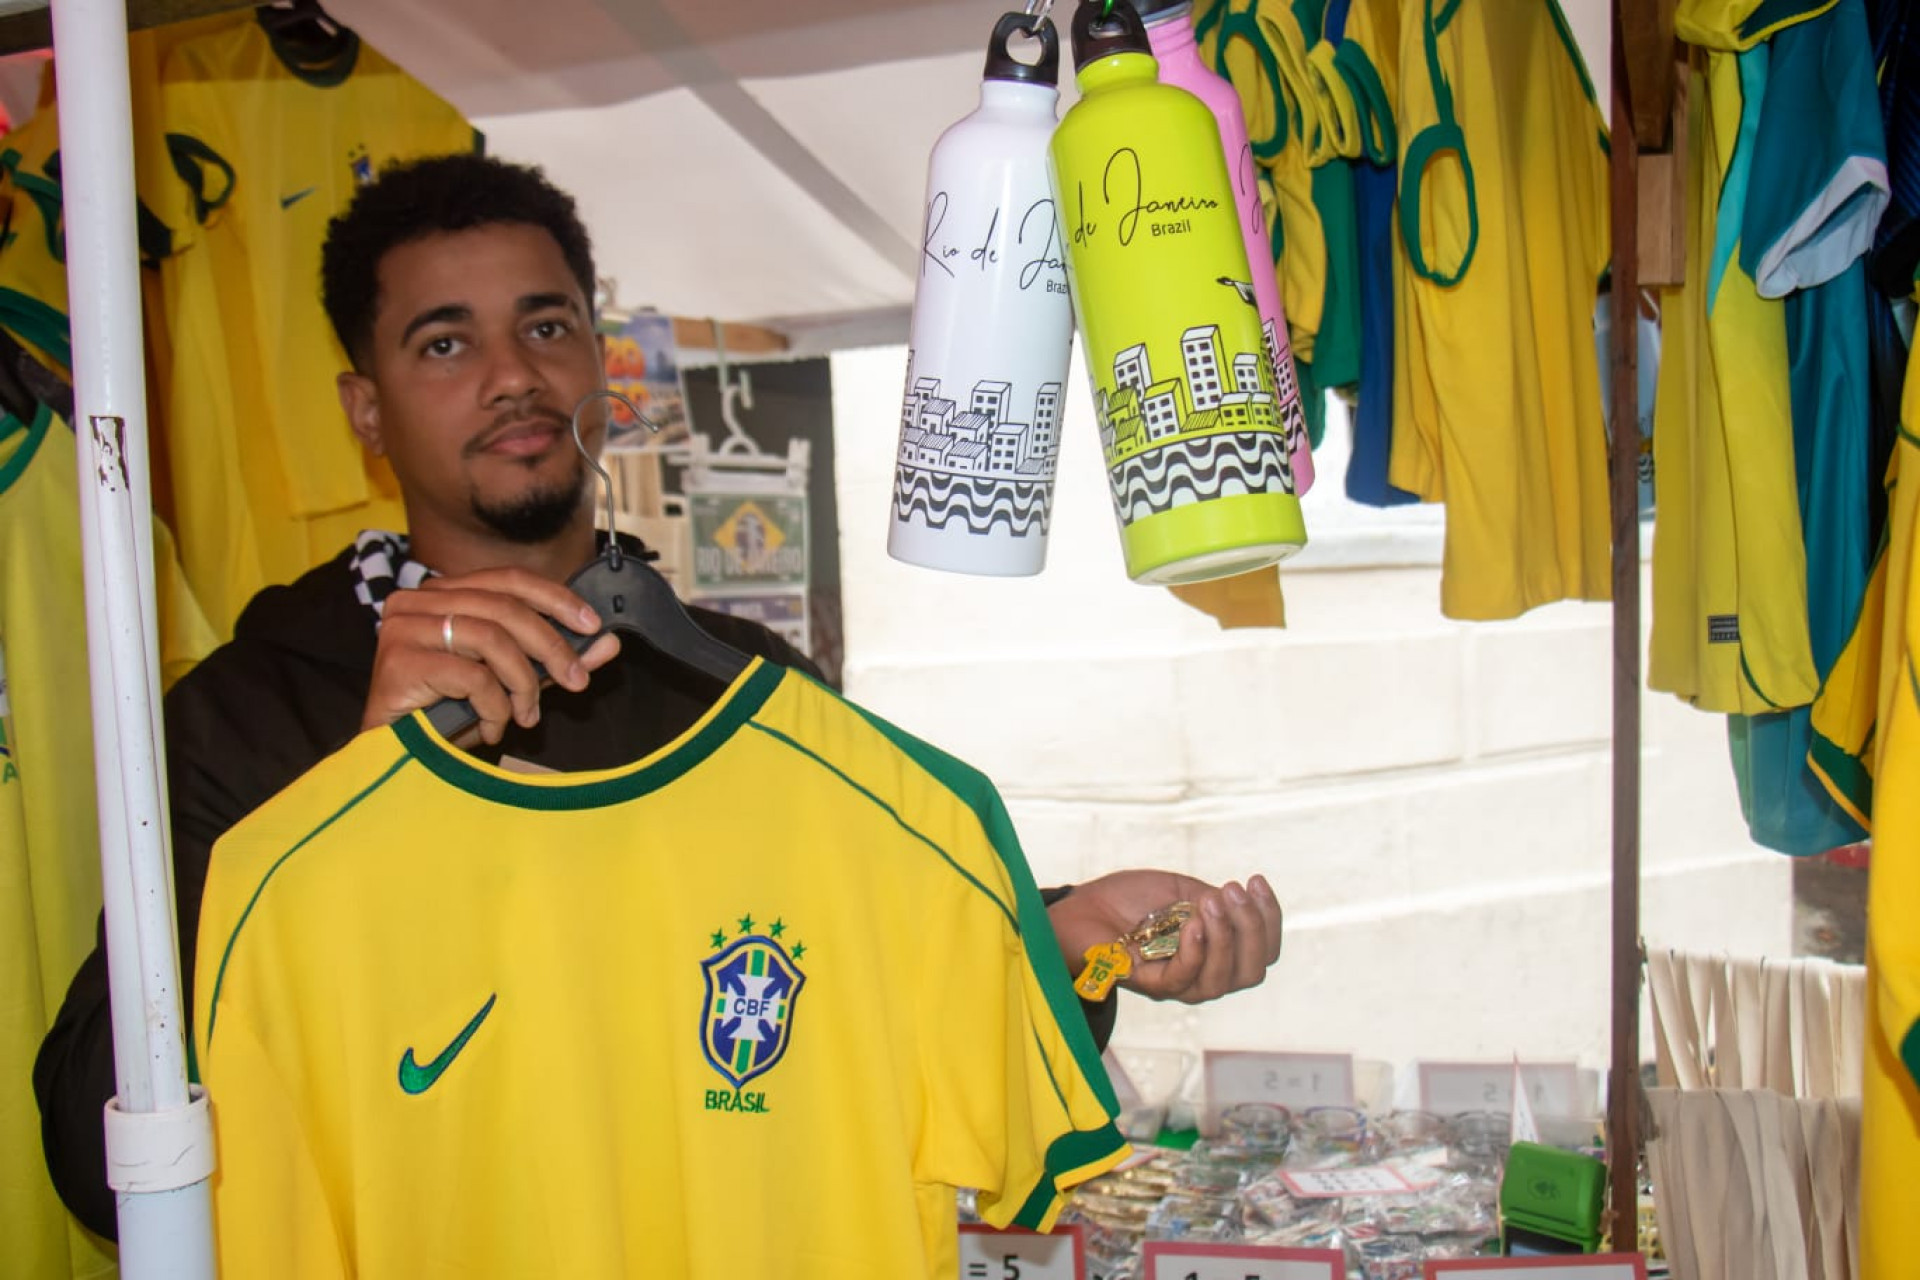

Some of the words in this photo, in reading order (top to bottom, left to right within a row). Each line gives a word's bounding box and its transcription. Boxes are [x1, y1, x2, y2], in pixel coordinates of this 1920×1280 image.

[1075, 180, 1097, 247] de
[1103, 146, 1219, 247] Janeiro
[923, 191, 959, 278] Rio
[971, 207, 999, 271] de
[1151, 219, 1191, 237] Brazil
[733, 997, 771, 1016] CBF
[704, 1089, 770, 1113] BRASIL
[1002, 1254, 1022, 1280] 5
